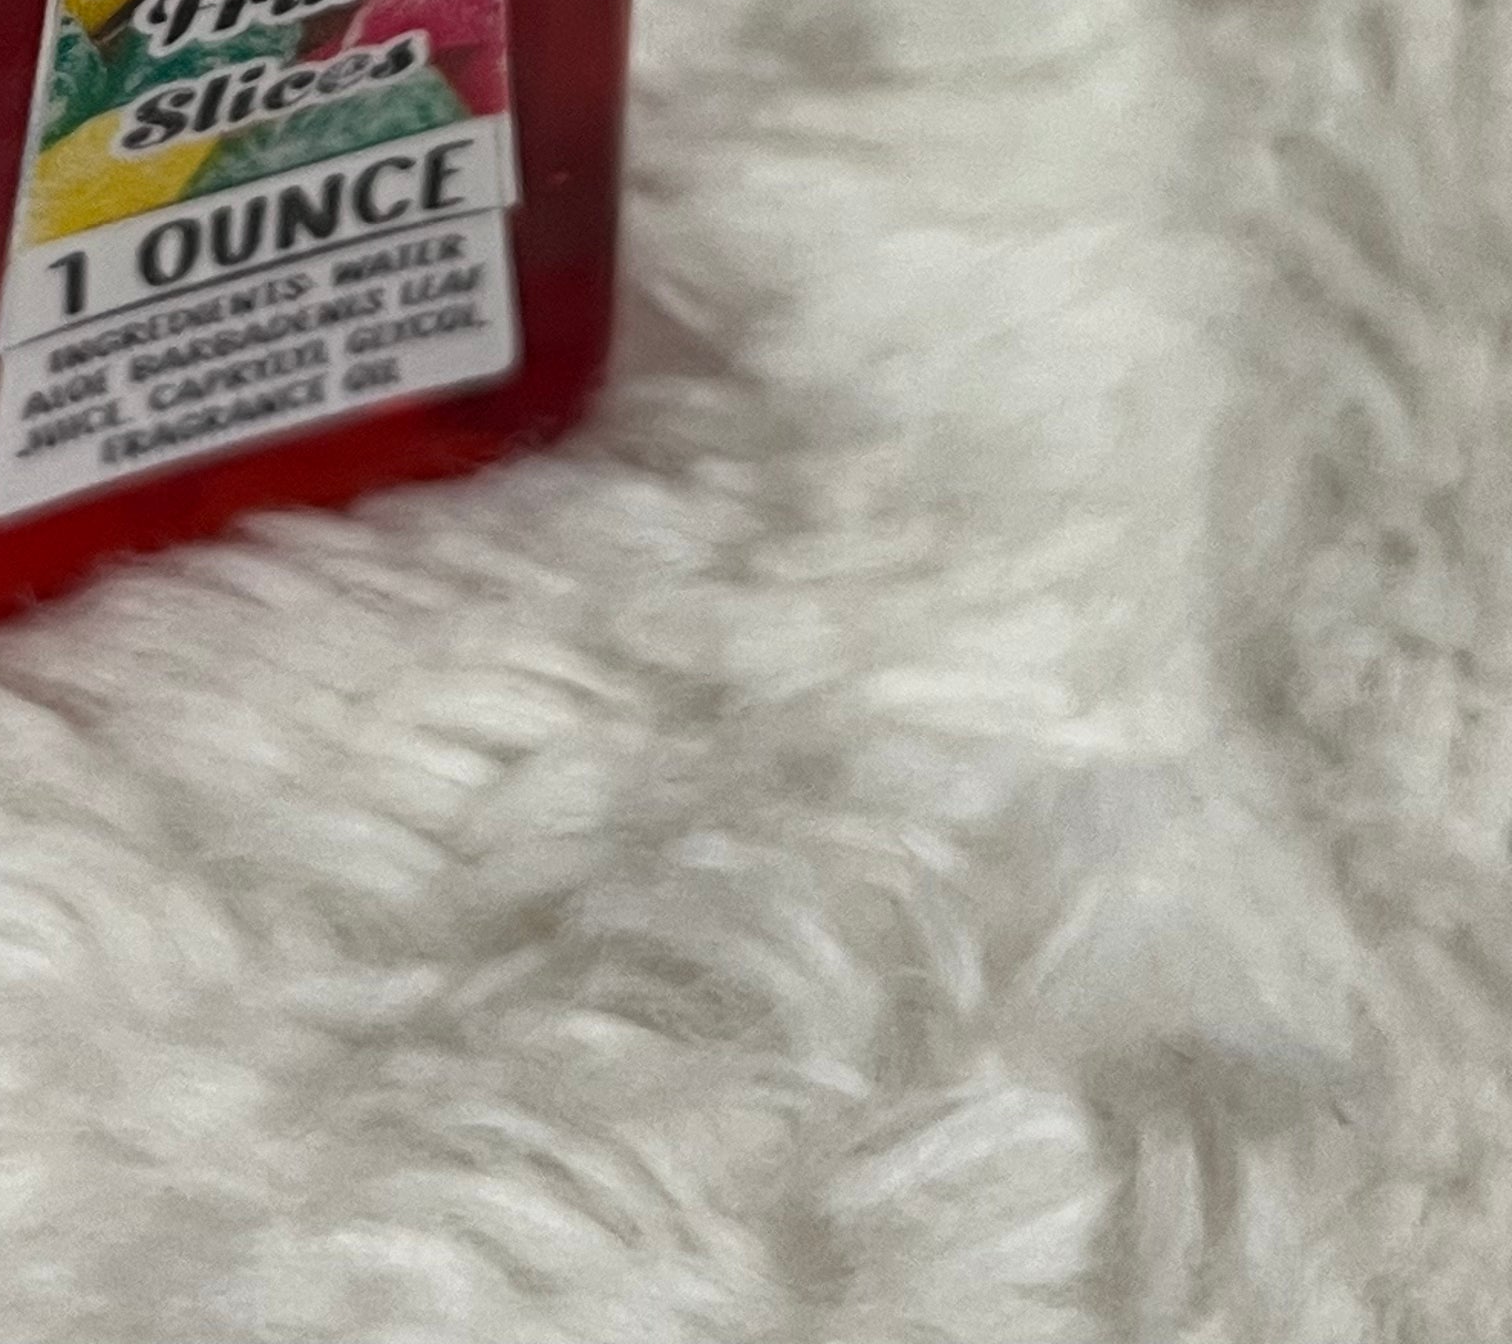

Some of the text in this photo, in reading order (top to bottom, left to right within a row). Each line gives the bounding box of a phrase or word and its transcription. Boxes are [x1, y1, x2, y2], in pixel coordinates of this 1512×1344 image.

[120, 37, 416, 150] Slices
[48, 138, 475, 315] 1 OUNCE
